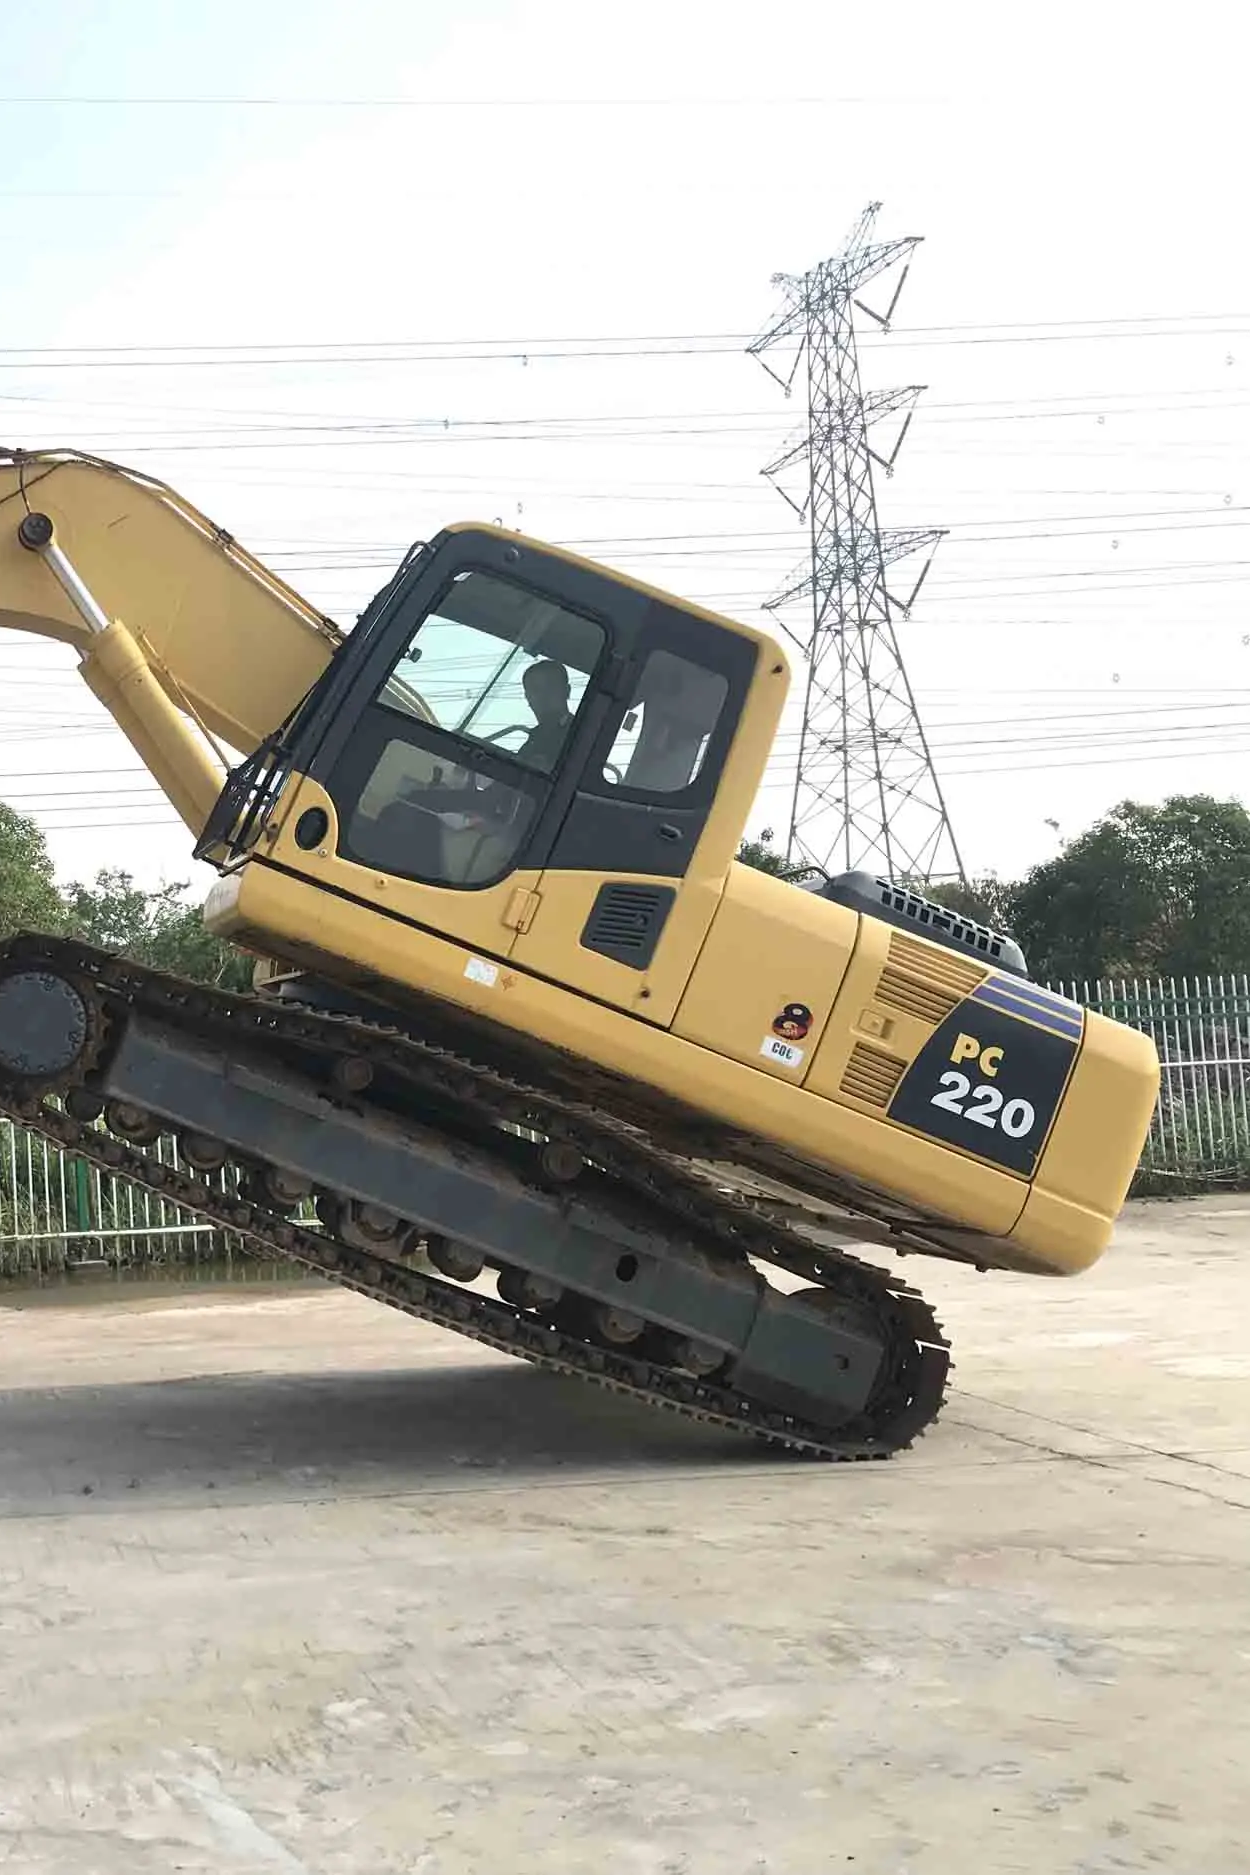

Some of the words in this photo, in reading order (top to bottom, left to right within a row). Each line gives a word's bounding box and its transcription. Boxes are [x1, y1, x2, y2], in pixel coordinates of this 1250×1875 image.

[772, 1003, 812, 1040] 8
[950, 1032, 1005, 1077] PC
[930, 1071, 1036, 1138] 220
